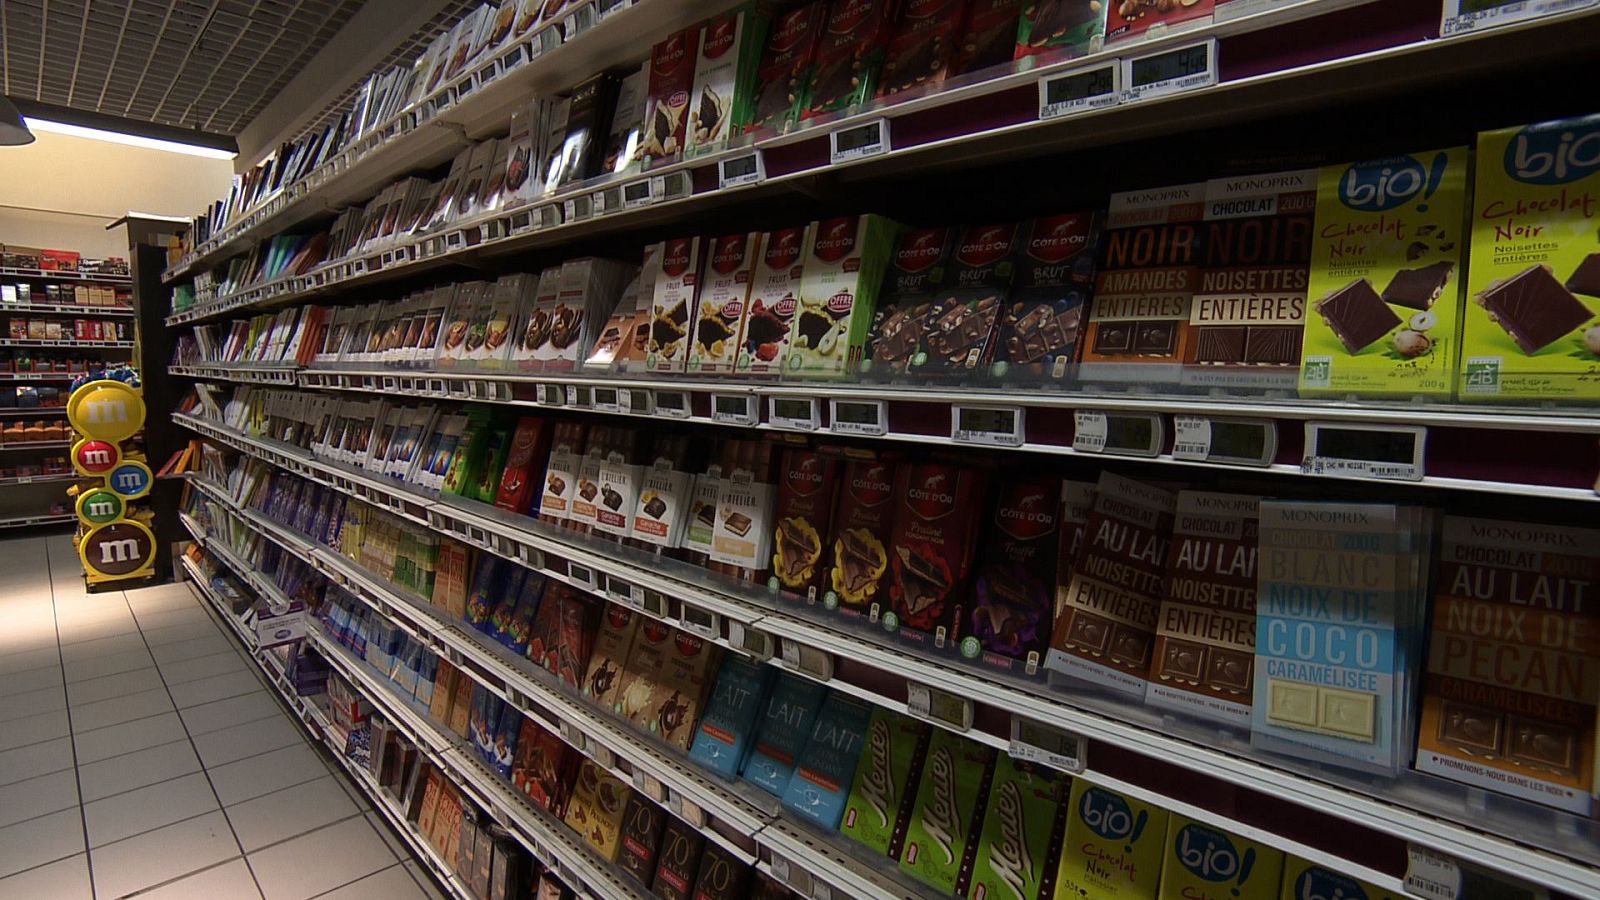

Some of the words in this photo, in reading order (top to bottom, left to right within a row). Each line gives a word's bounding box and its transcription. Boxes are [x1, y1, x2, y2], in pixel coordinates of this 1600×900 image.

[1126, 189, 1191, 205] MONOPRIX
[1226, 176, 1304, 193] MONOPRIX
[1213, 199, 1273, 215] CHOCOLAT
[1482, 188, 1597, 221] Chocolat
[1321, 215, 1406, 241] Chocolat
[1495, 217, 1544, 243] Noir
[1106, 225, 1195, 269] NOIR
[1205, 217, 1312, 266] NOIR
[1330, 239, 1367, 259] Noir
[1494, 241, 1560, 255] Noisettes
[1033, 264, 1073, 279] BRUT
[1493, 254, 1549, 266] entières
[1103, 270, 1187, 293] AMANDES
[1202, 268, 1306, 293] NOISETTES
[830, 294, 853, 307] OFFRE
[1097, 294, 1183, 319] ENTIÈRES
[1199, 293, 1303, 321] ENTIÈRES
[86, 400, 128, 424] m
[84, 449, 110, 465] m
[118, 472, 141, 488] m
[89, 500, 115, 516] m
[909, 488, 930, 502] CÔTE
[931, 491, 954, 506] D'OR
[1119, 482, 1173, 508] MONOPRI
[1195, 497, 1257, 513] MONOPRI
[1000, 507, 1026, 521] CÔTE
[1027, 511, 1054, 527] D'OR
[1103, 498, 1152, 523] CHOCOLAT
[1281, 509, 1369, 526] MONOPRIX
[1182, 516, 1238, 535] CHOCOLAT
[1471, 524, 1579, 548] MONOPRIX
[99, 538, 141, 564] m
[1093, 519, 1129, 553] AU
[1129, 529, 1168, 568] LAI
[1175, 538, 1212, 573] AU
[1215, 542, 1258, 579] LAI
[1272, 551, 1379, 588] BLANC
[1456, 545, 1537, 569] CHOCOLAT
[1170, 576, 1257, 611] NOISETTE
[1450, 564, 1497, 600] AU
[1510, 571, 1591, 613] LAIT
[1270, 583, 1331, 621] NOIX
[1342, 591, 1378, 625] DE
[1448, 599, 1527, 642] NOIX
[1540, 613, 1586, 653] DE
[1267, 619, 1378, 669] COCO
[766, 695, 809, 729] LAIT
[812, 719, 861, 754] LAIT
[861, 719, 896, 829] Menier
[1440, 757, 1506, 783] PROMENONS-NOUS
[631, 800, 653, 836] 70
[922, 745, 963, 866] Menier
[666, 828, 689, 866] 70
[989, 780, 1036, 900] Menier
[704, 851, 730, 891] 70
[1082, 843, 1137, 883] Chocolat
[1086, 860, 1111, 879] Noir
